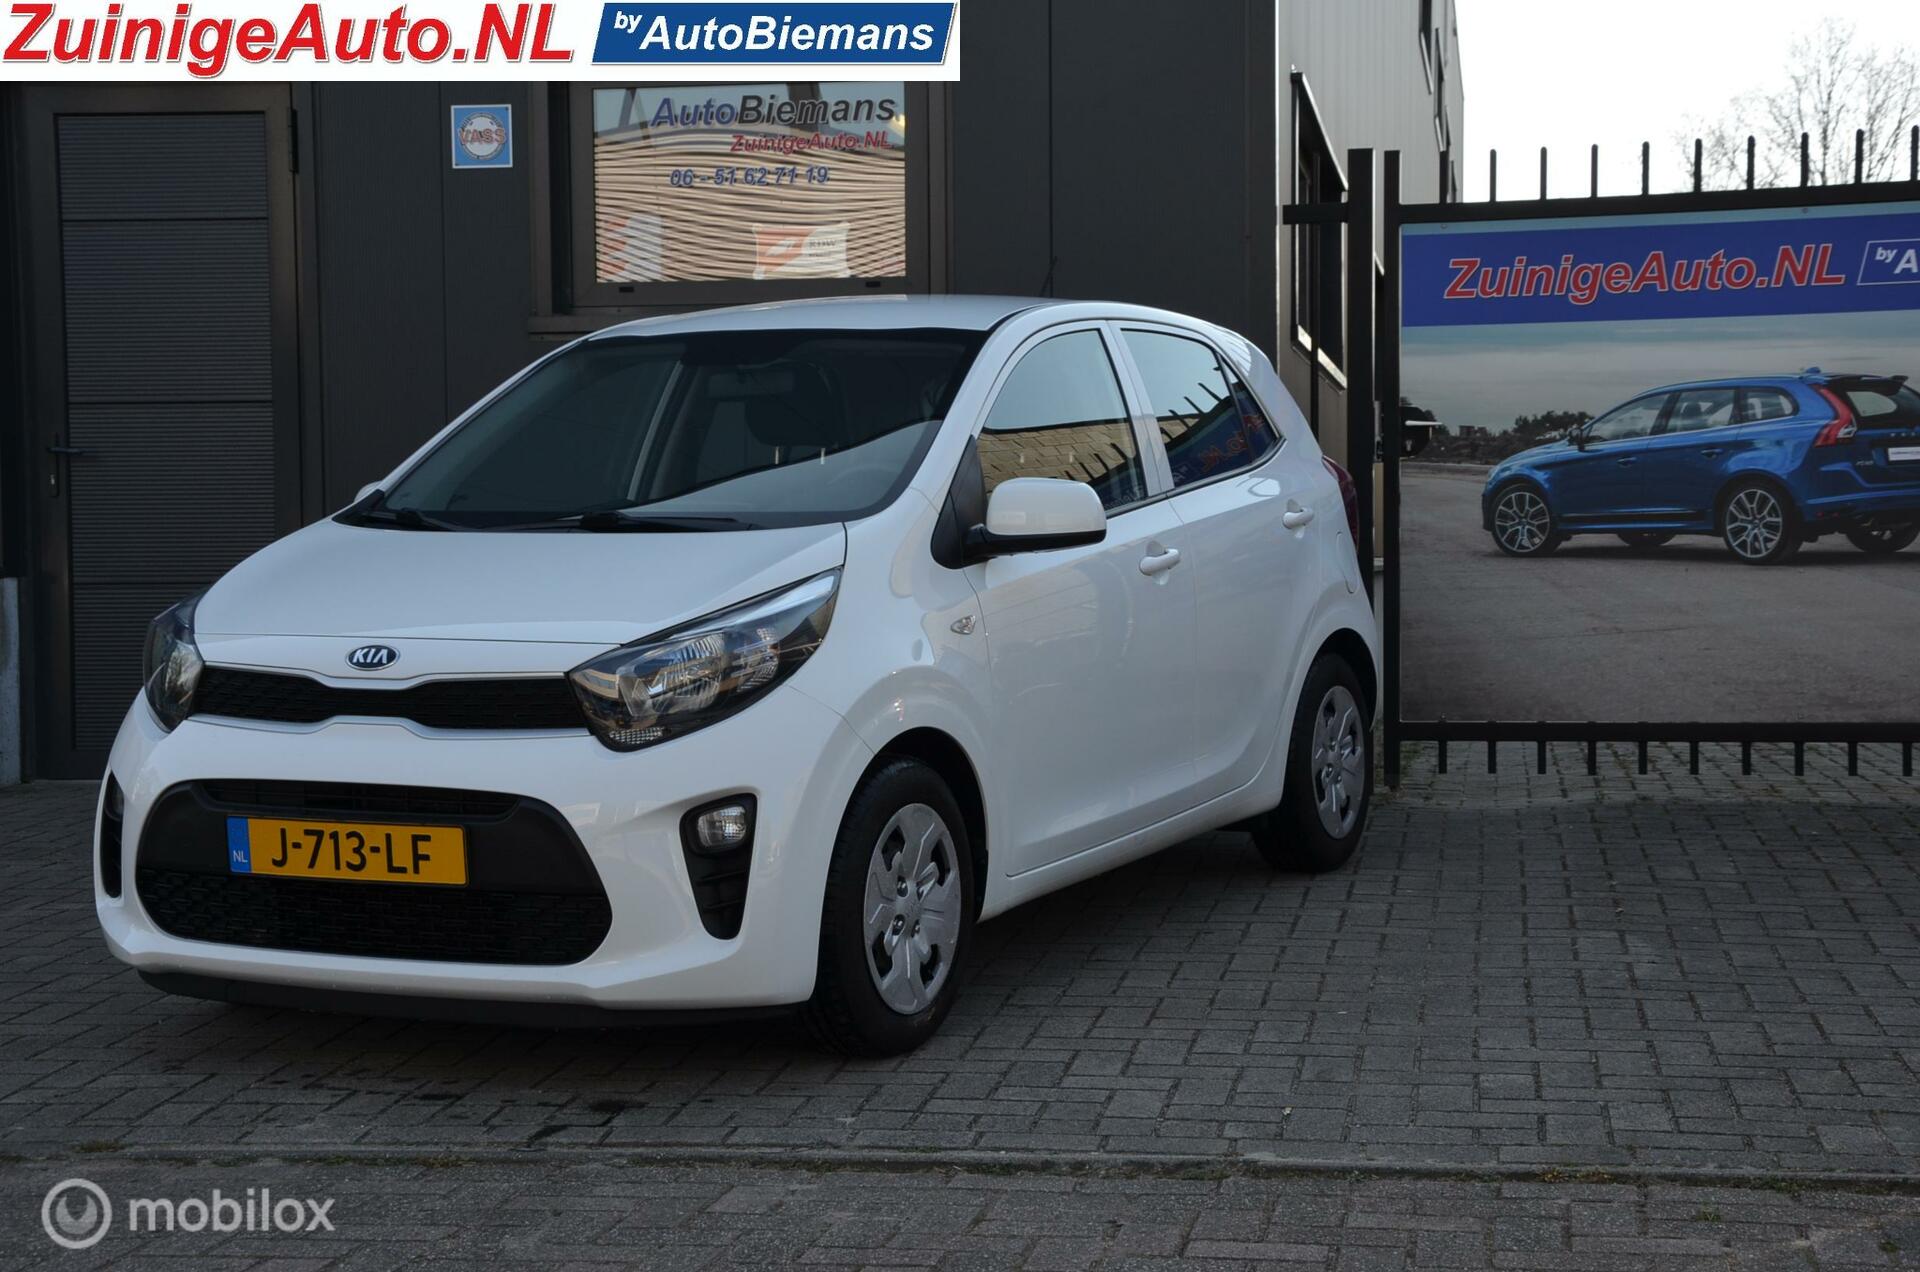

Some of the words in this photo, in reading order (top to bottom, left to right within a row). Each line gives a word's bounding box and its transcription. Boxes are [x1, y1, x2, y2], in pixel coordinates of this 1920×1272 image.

[650, 94, 897, 127] AutoBiemans
[729, 130, 892, 154] ZuinigeAuto.NL
[669, 168, 695, 187] 06
[713, 167, 737, 186] 51
[743, 167, 769, 186] 62
[774, 167, 798, 185] 71
[805, 165, 829, 184] 19
[1875, 246, 1899, 263] by
[1443, 242, 1847, 306] ZuinigeAuto.NL
[352, 647, 389, 664] KIA
[232, 849, 249, 864] NL
[271, 826, 433, 875] J-713-LF
